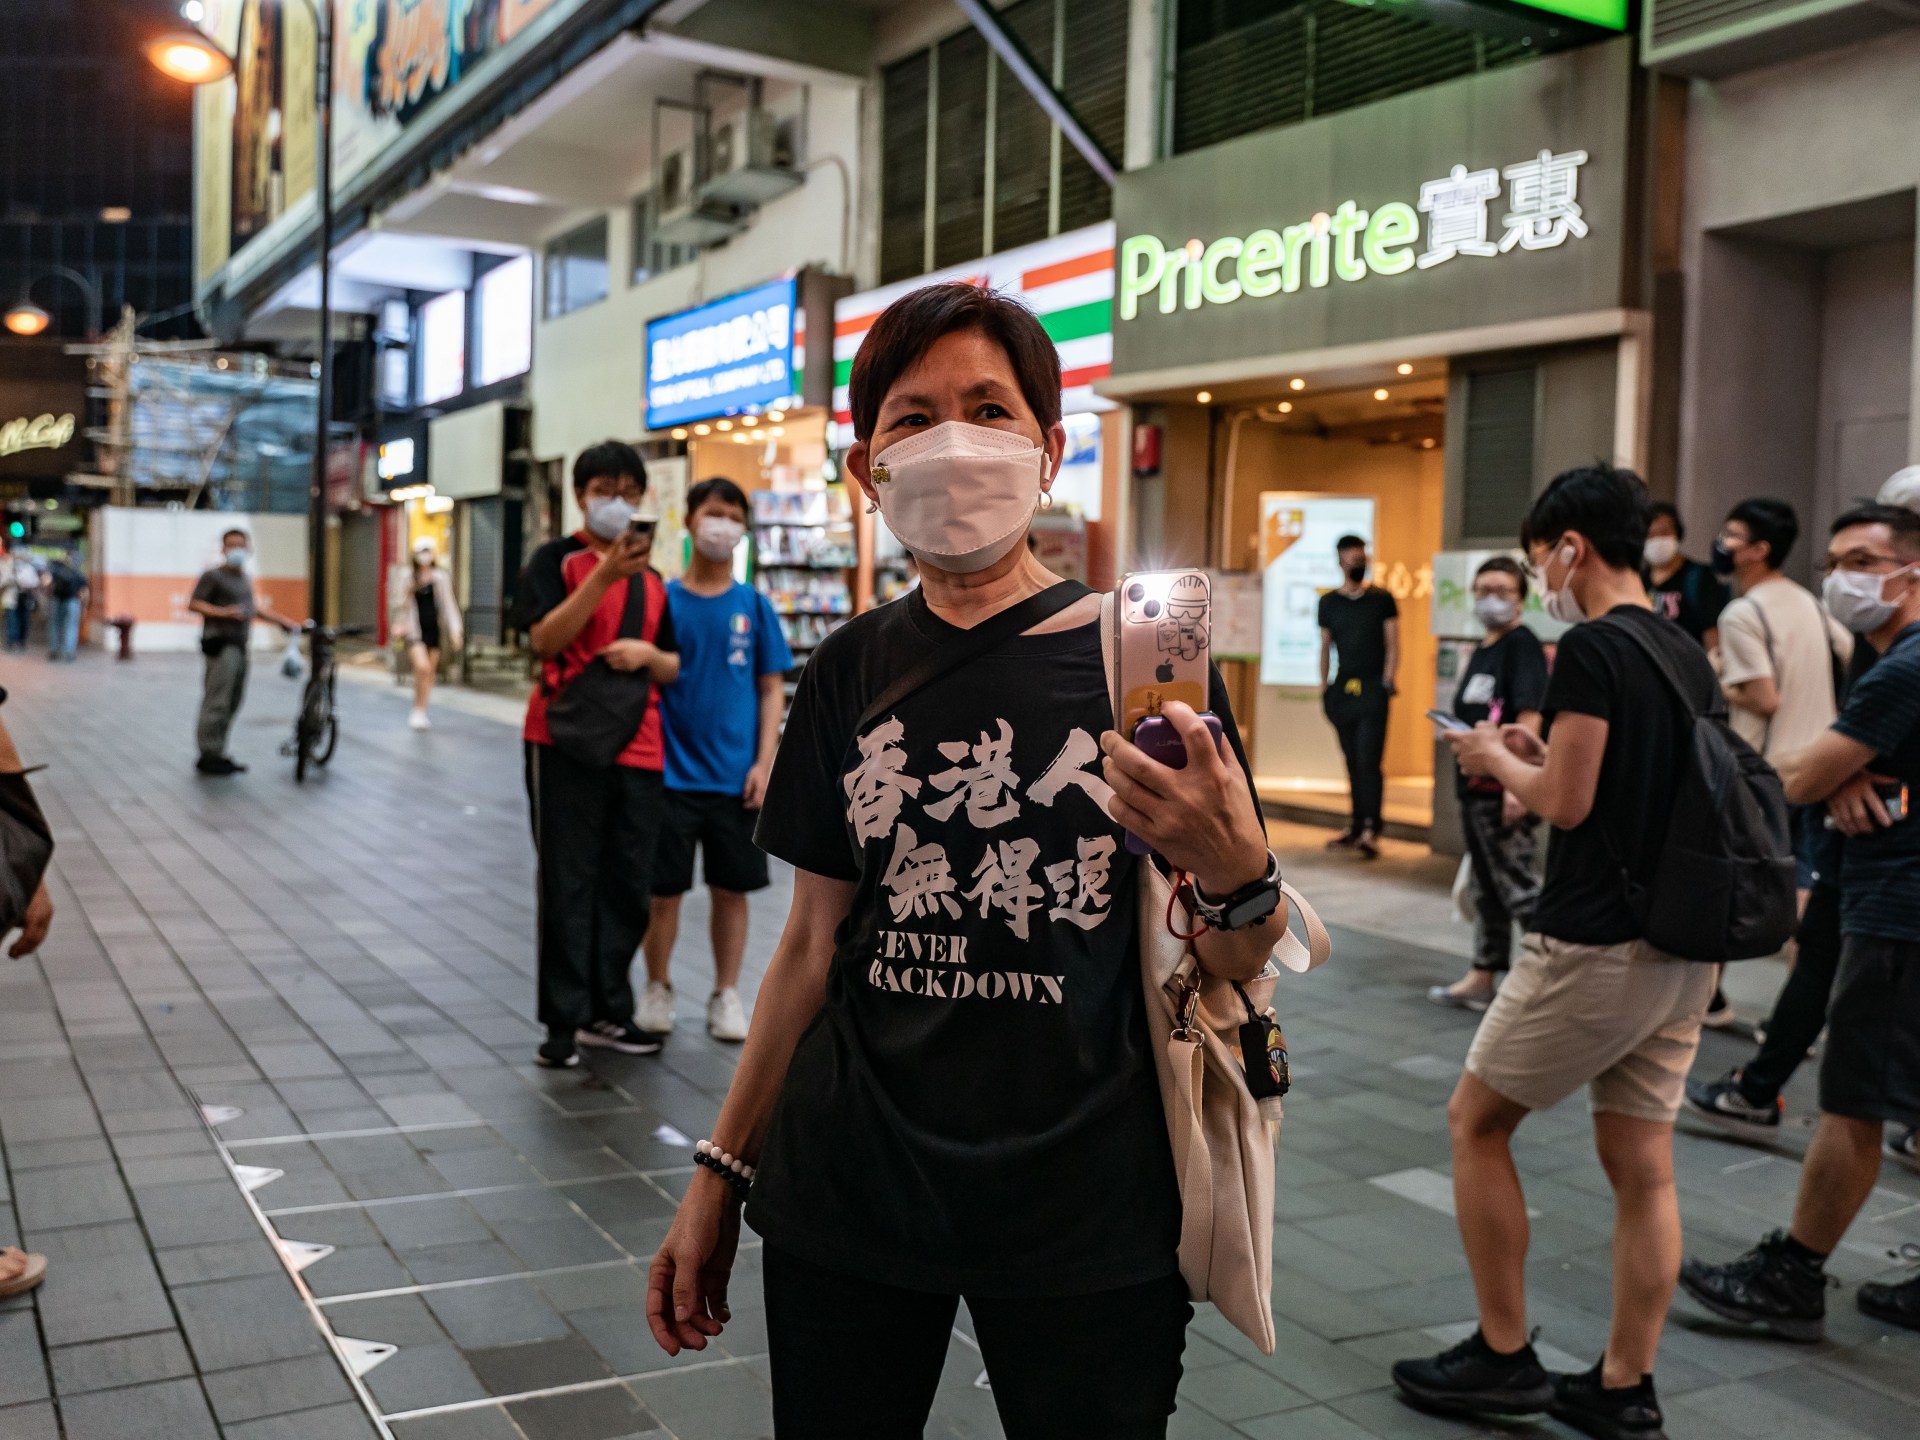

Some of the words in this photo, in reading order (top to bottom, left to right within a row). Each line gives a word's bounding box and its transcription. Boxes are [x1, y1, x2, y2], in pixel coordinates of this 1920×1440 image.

[1120, 199, 1420, 321] Pricerite
[1416, 148, 1589, 270] 實惠
[844, 715, 1119, 848] 香港人
[881, 822, 1117, 942] 無得退
[876, 930, 969, 964] EVER
